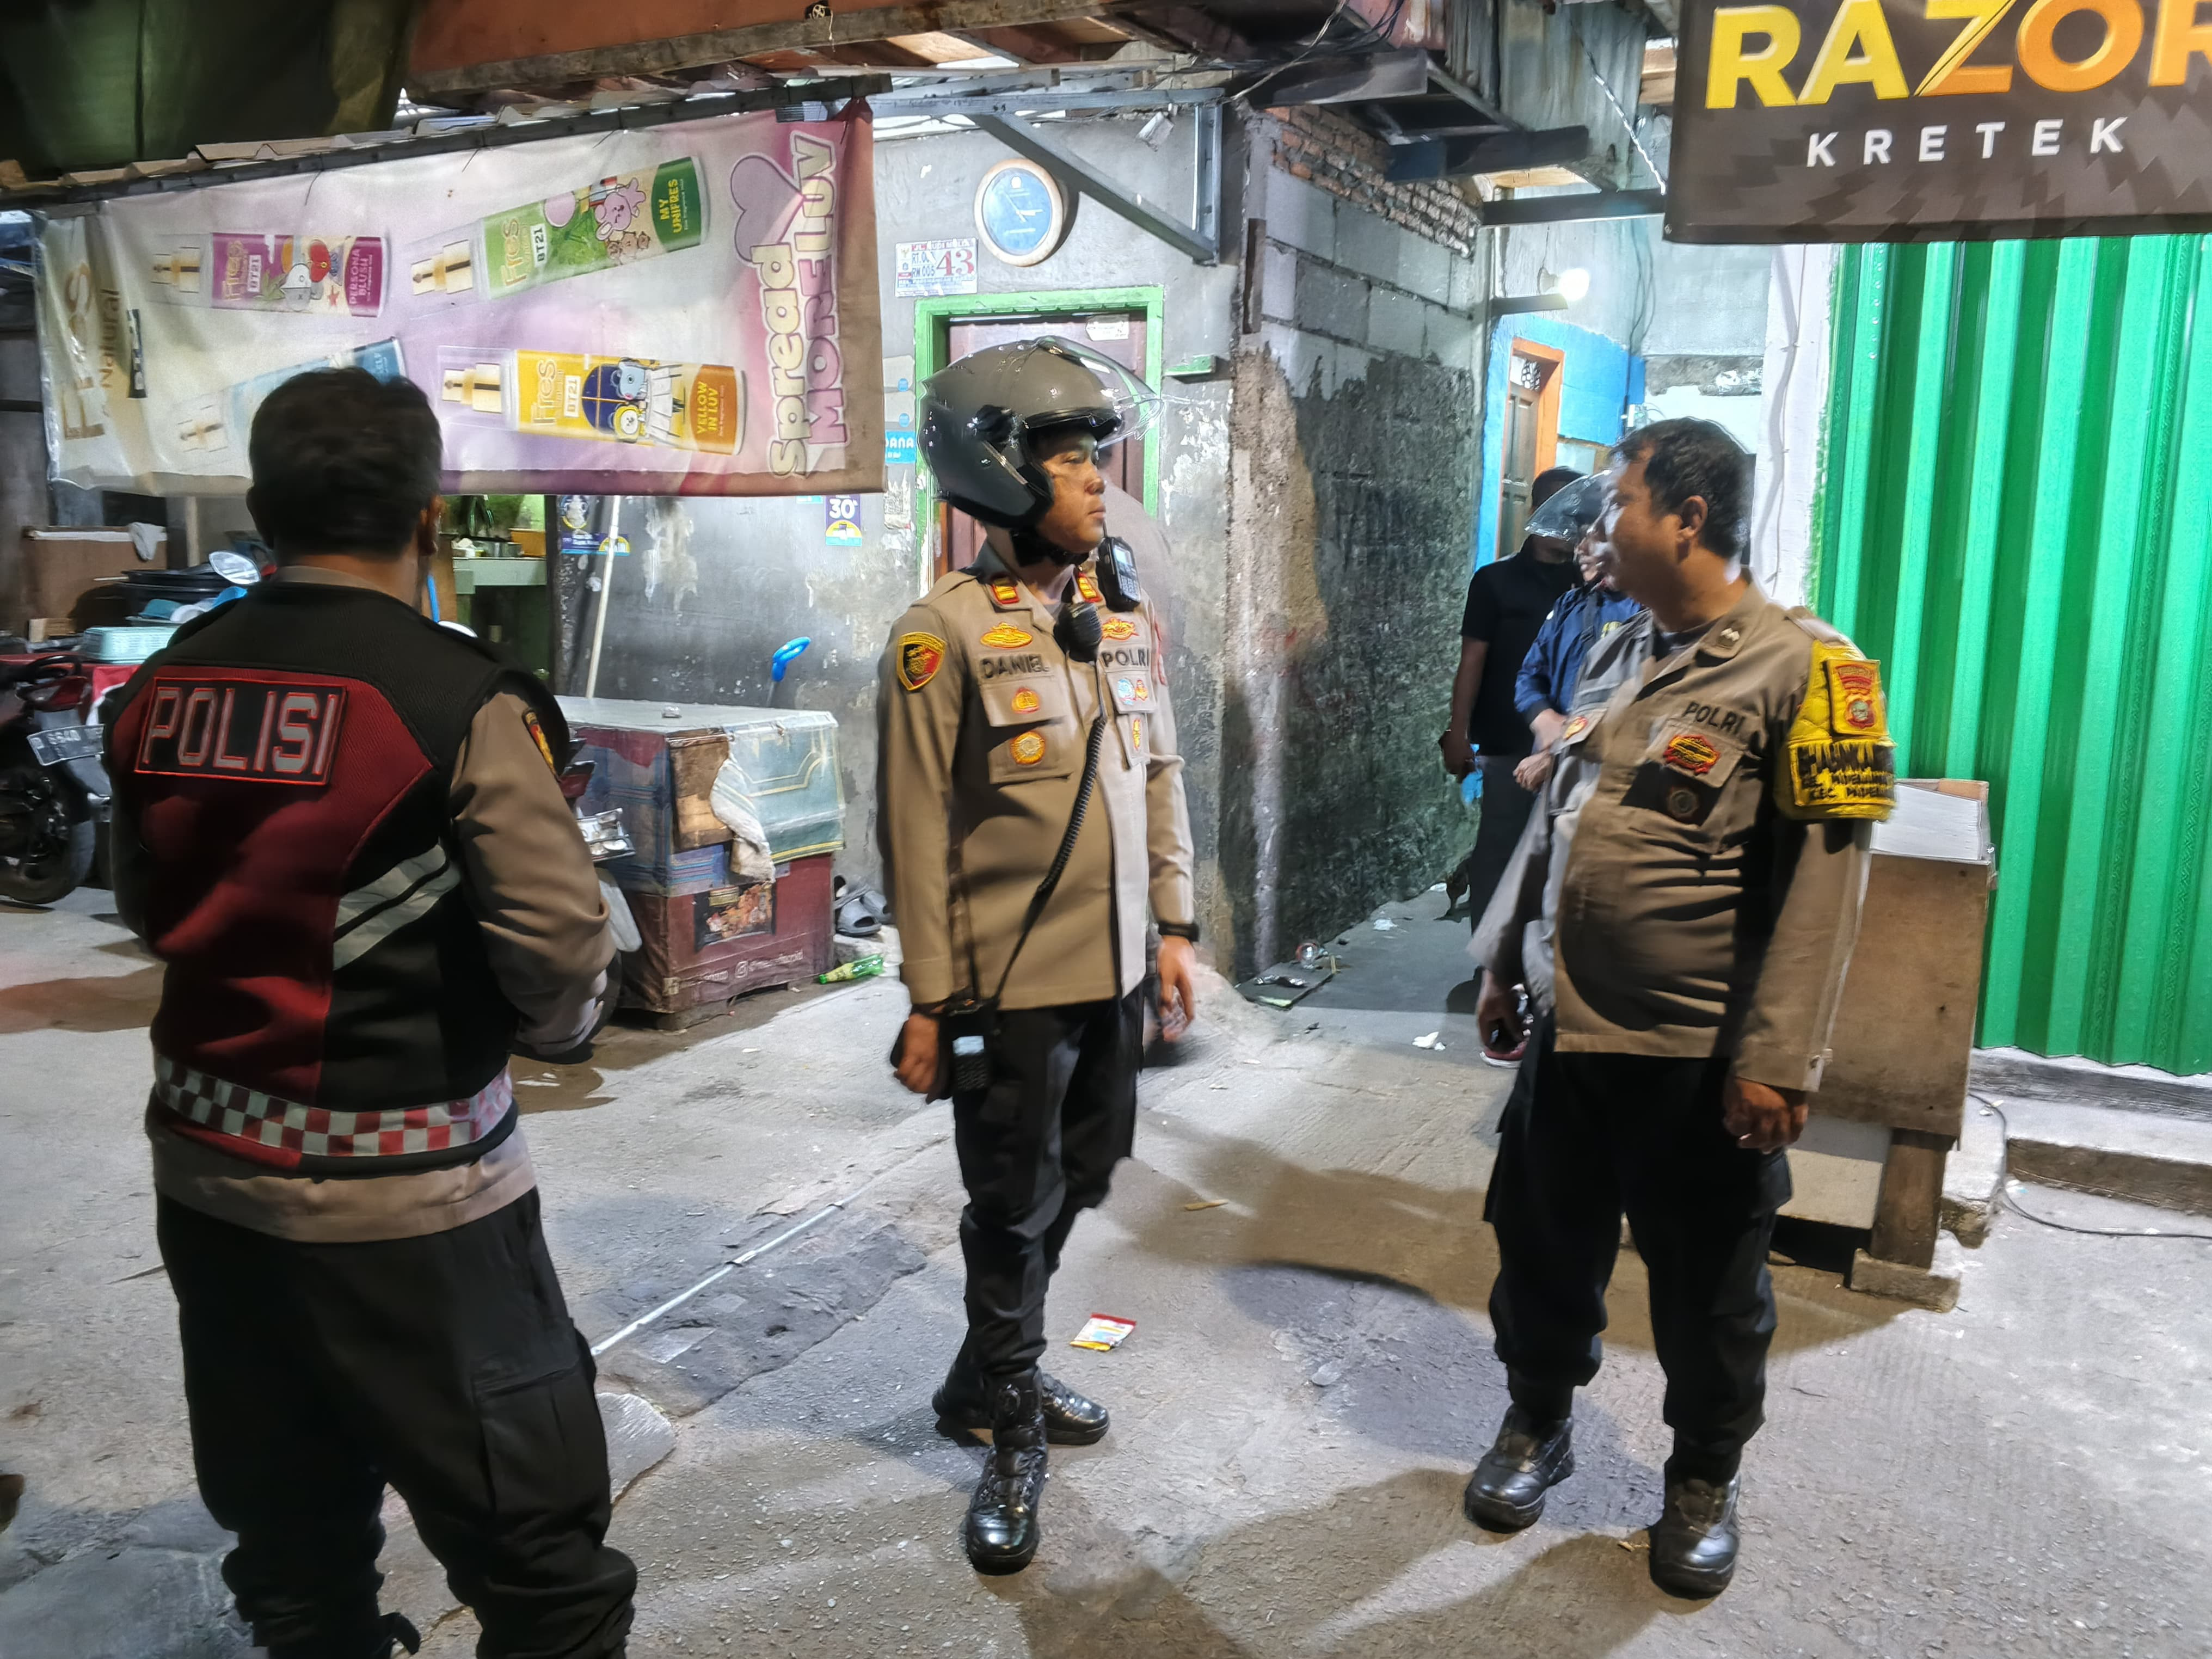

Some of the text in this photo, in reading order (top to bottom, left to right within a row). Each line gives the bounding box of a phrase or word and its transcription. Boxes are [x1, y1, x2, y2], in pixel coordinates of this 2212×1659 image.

[1806, 116, 2128, 168] KRETEK
[659, 199, 669, 220] MY
[668, 179, 682, 233] UNIFRES
[501, 218, 526, 287] Fres
[534, 227, 545, 262] BT21
[936, 249, 974, 276] 43
[349, 249, 360, 304] PERSONA
[359, 258, 368, 296] BLUSH
[794, 135, 847, 444] MORE LUV
[750, 243, 812, 477] Spread
[532, 360, 556, 425] Fres
[697, 381, 707, 434] YELLOW
[708, 388, 718, 431] IN LUV
[981, 654, 1049, 678] DANIEL
[1102, 648, 1150, 667] POLRI
[143, 687, 339, 775] POLISI
[1681, 701, 1746, 735] POLRI
